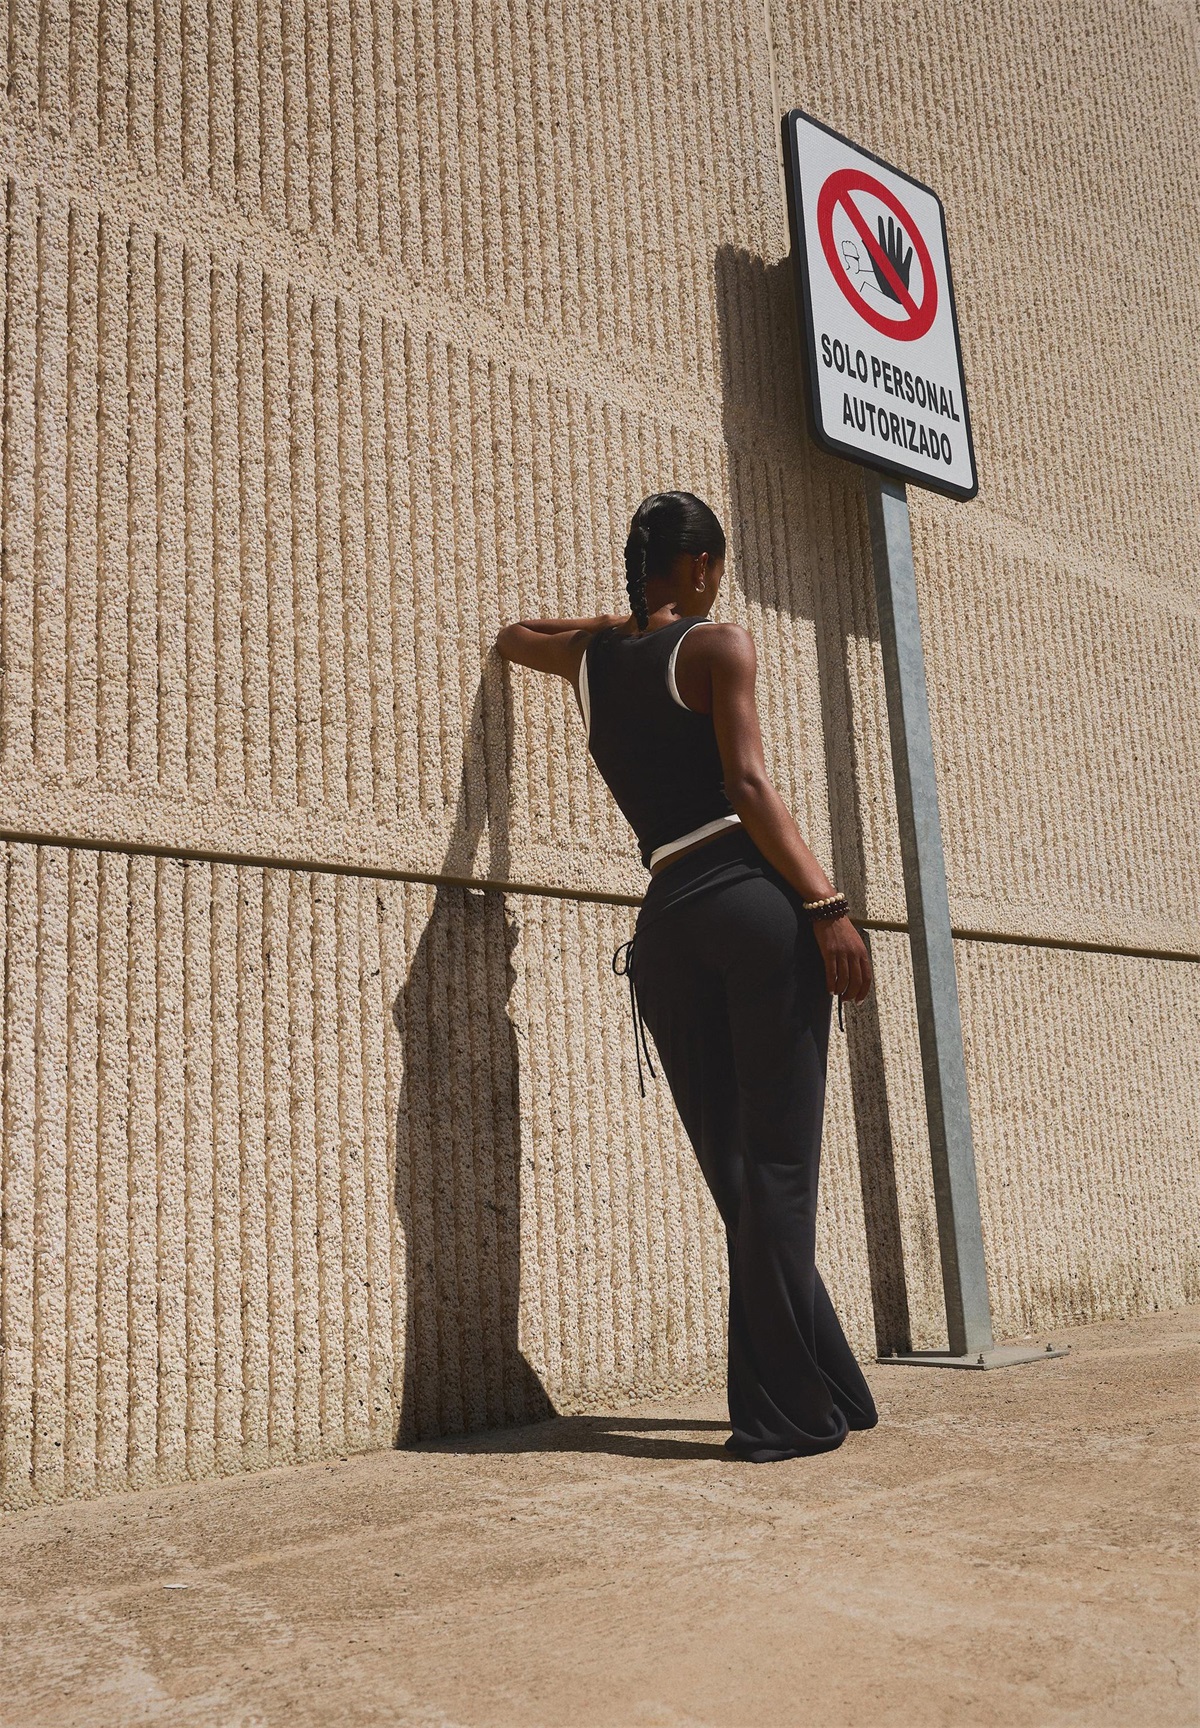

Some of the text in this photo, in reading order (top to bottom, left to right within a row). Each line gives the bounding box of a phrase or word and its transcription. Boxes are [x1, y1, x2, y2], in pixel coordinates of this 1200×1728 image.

[821, 333, 960, 422] SOLO PERSONAL
[843, 392, 952, 465] AUTORIZADO
